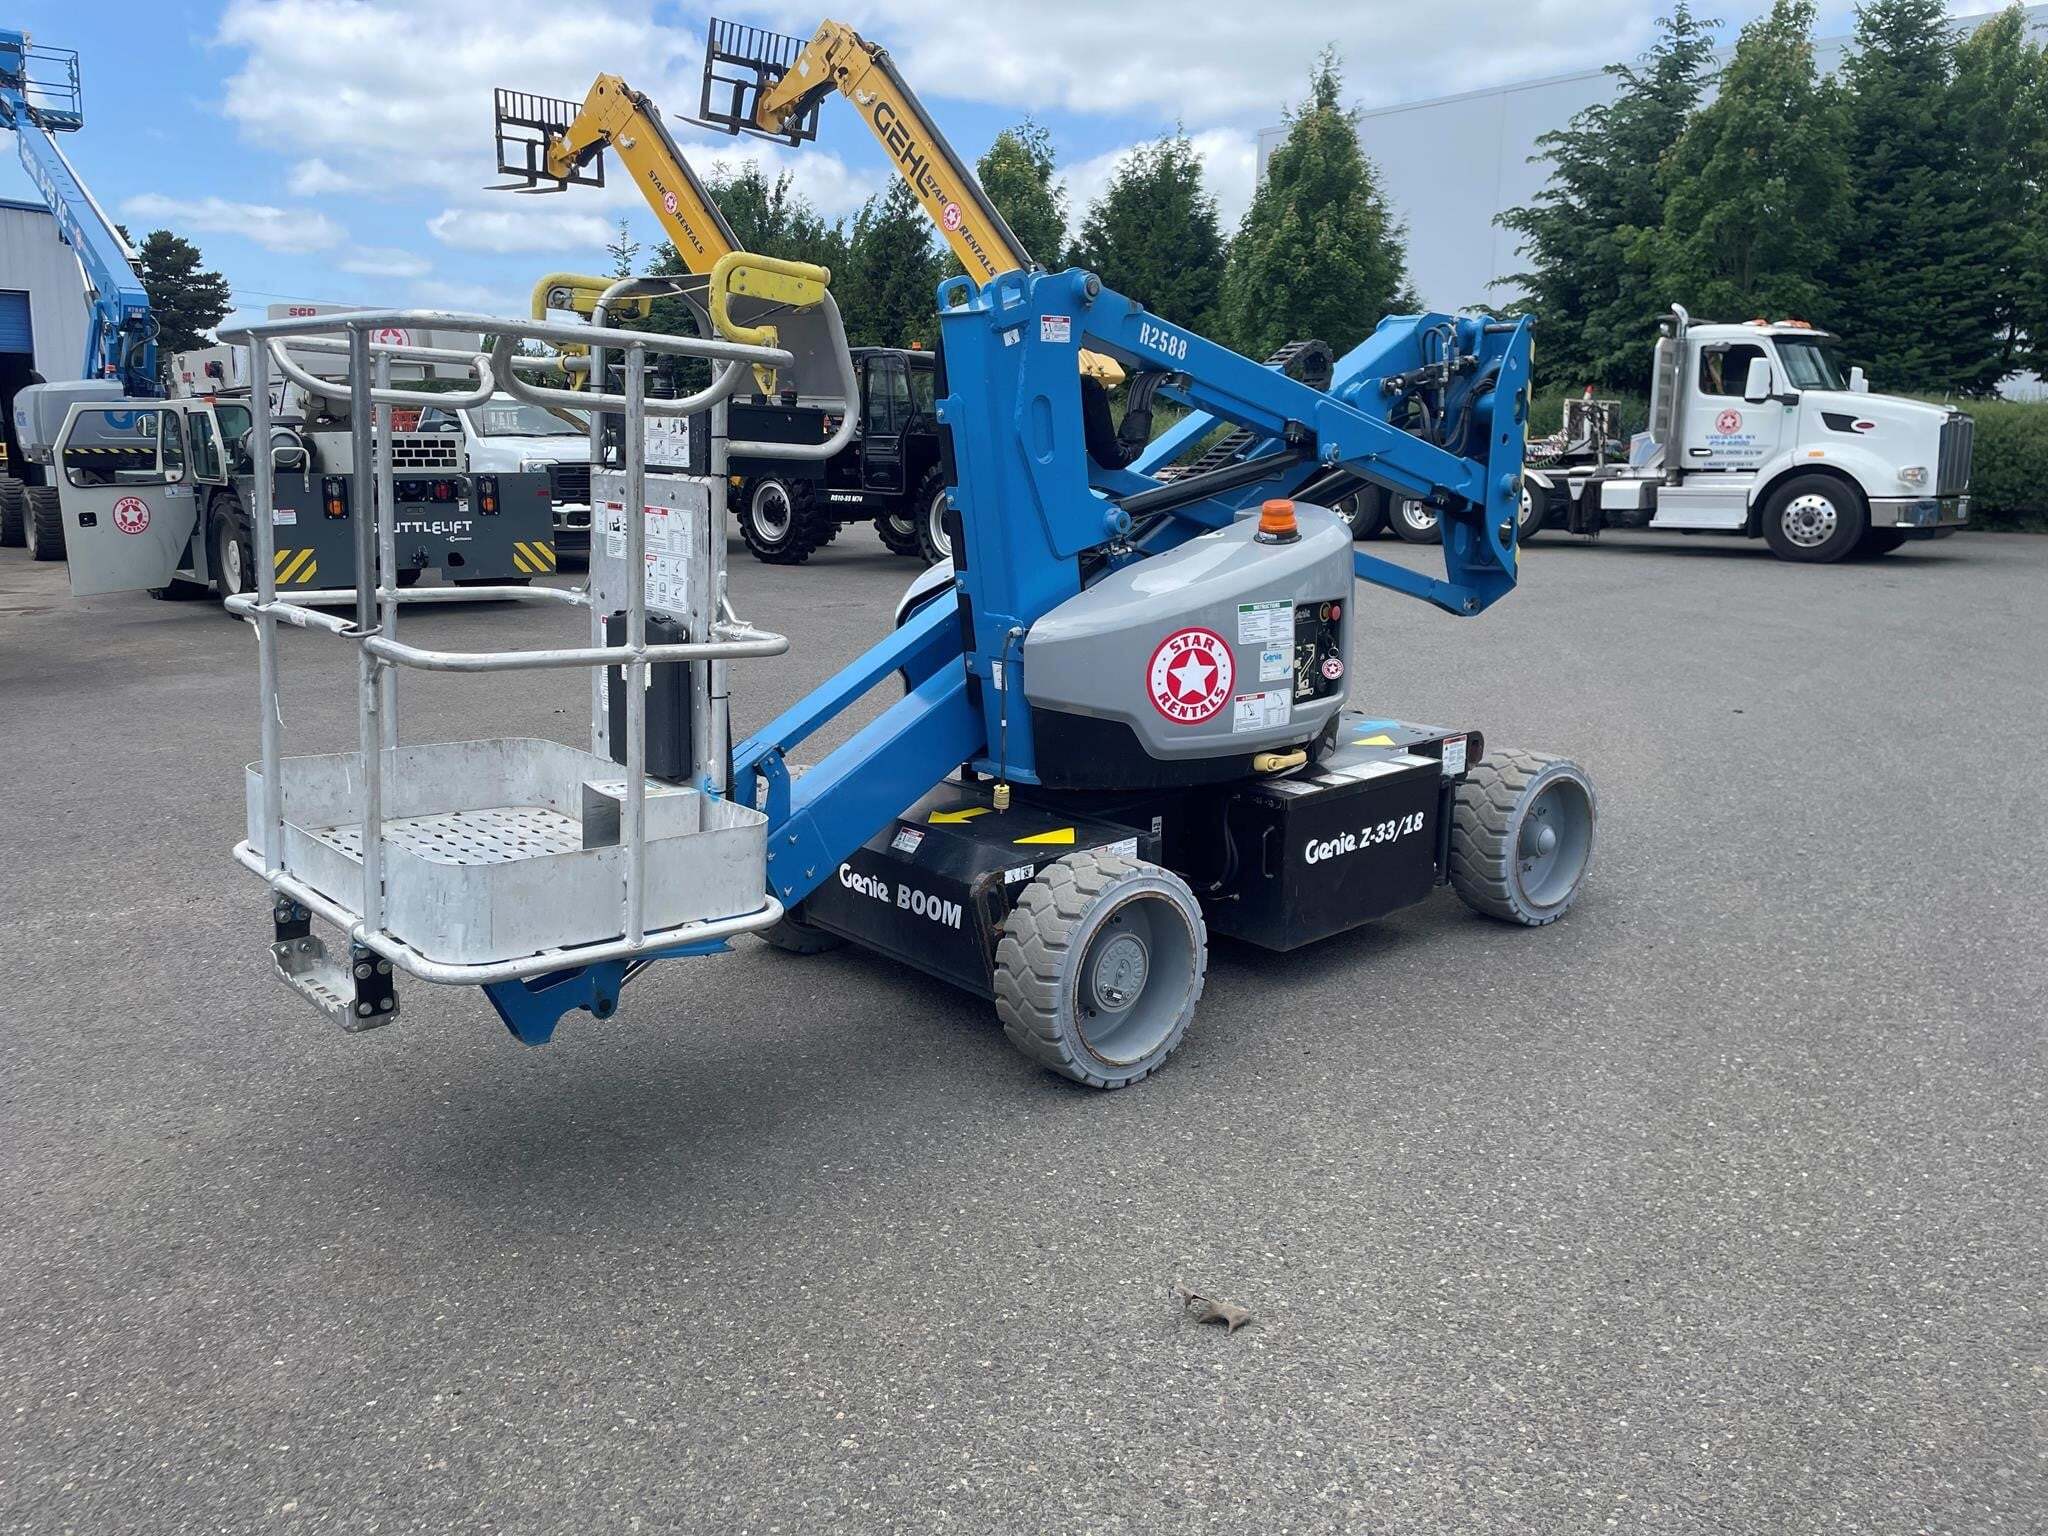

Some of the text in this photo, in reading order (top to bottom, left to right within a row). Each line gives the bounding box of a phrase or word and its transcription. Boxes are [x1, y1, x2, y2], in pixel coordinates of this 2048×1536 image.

[874, 101, 930, 199] GEHL
[648, 170, 705, 254] STAR RENTALS
[924, 174, 998, 278] STAR RENTALS
[1139, 321, 1188, 361] R2588
[119, 520, 147, 532] RENTALS
[120, 499, 140, 507] STAR
[1169, 634, 1216, 655] STAR
[1157, 687, 1226, 718] RENTALS
[1305, 811, 1425, 865] Genie Z-33/18
[838, 863, 963, 930] Genie BOOM
